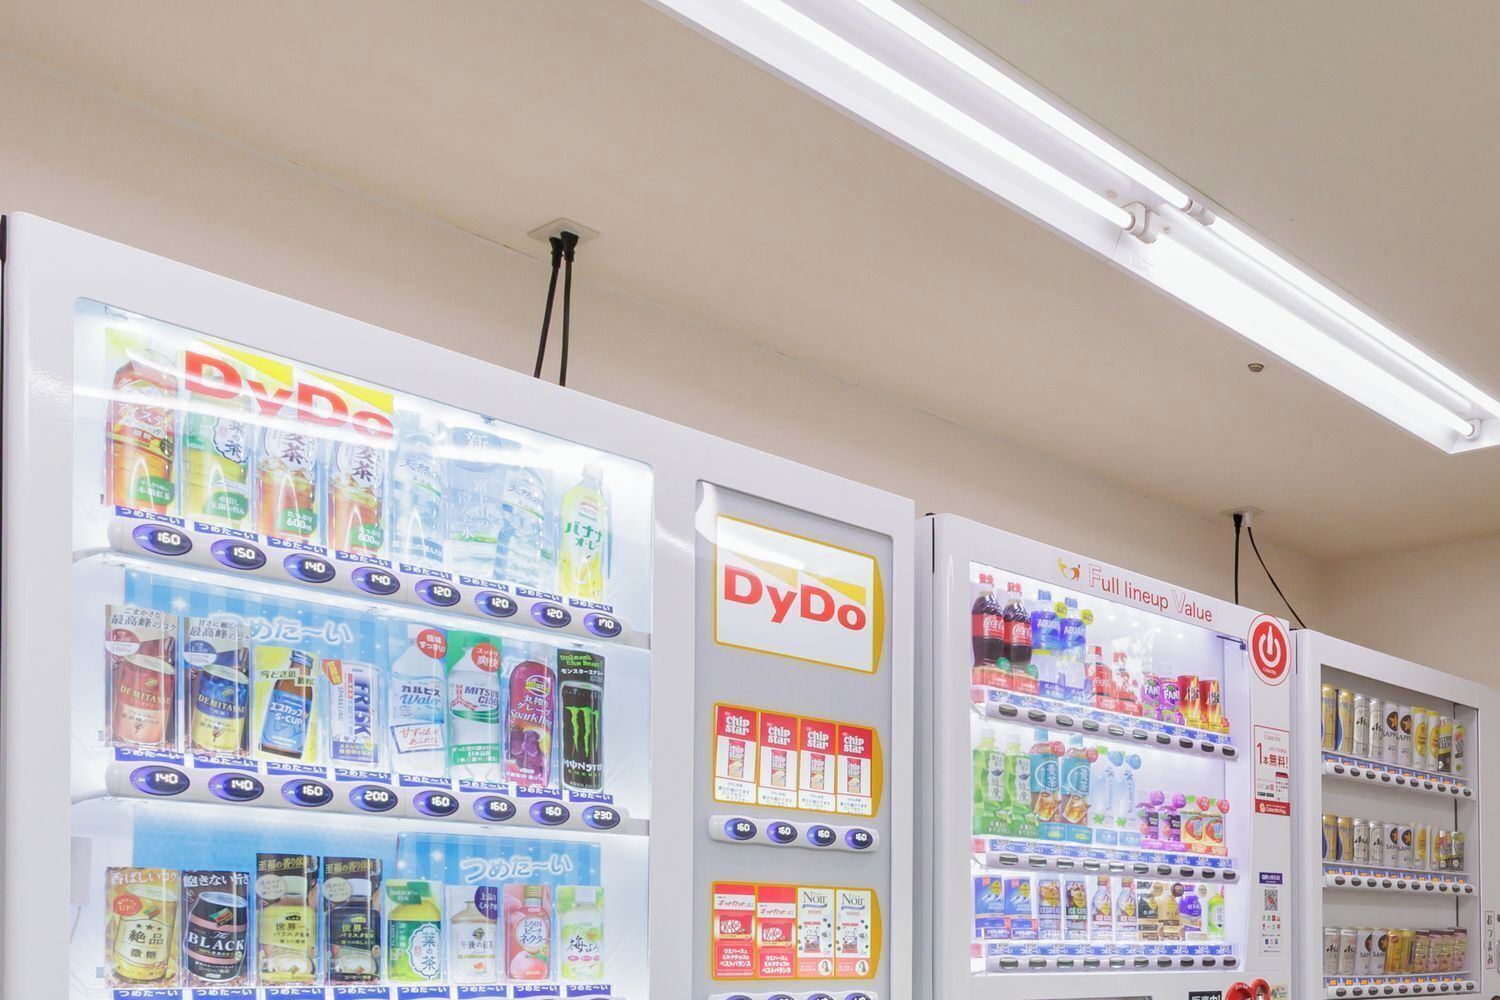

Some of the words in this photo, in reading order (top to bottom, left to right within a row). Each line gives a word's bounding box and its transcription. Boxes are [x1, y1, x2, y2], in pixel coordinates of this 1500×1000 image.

[185, 350, 394, 440] DyDo
[157, 532, 181, 545] 160
[234, 547, 256, 560] 150
[304, 561, 326, 574] 140
[371, 574, 391, 586] 140
[433, 586, 452, 598] 120
[724, 564, 867, 631] DyDo
[1089, 563, 1120, 595] Full
[1125, 580, 1169, 611] lineup
[1172, 590, 1212, 622] Value
[491, 598, 510, 609] 120
[546, 608, 564, 619] 120
[155, 772, 179, 784] 140
[231, 779, 254, 790] 140
[302, 784, 323, 796] 160
[365, 790, 389, 803] 200
[431, 796, 450, 807] 160
[490, 801, 508, 812] 160
[545, 806, 562, 816] 160
[593, 810, 613, 820] 230
[129, 929, 164, 945] 絶品
[188, 932, 245, 951] BLACK
